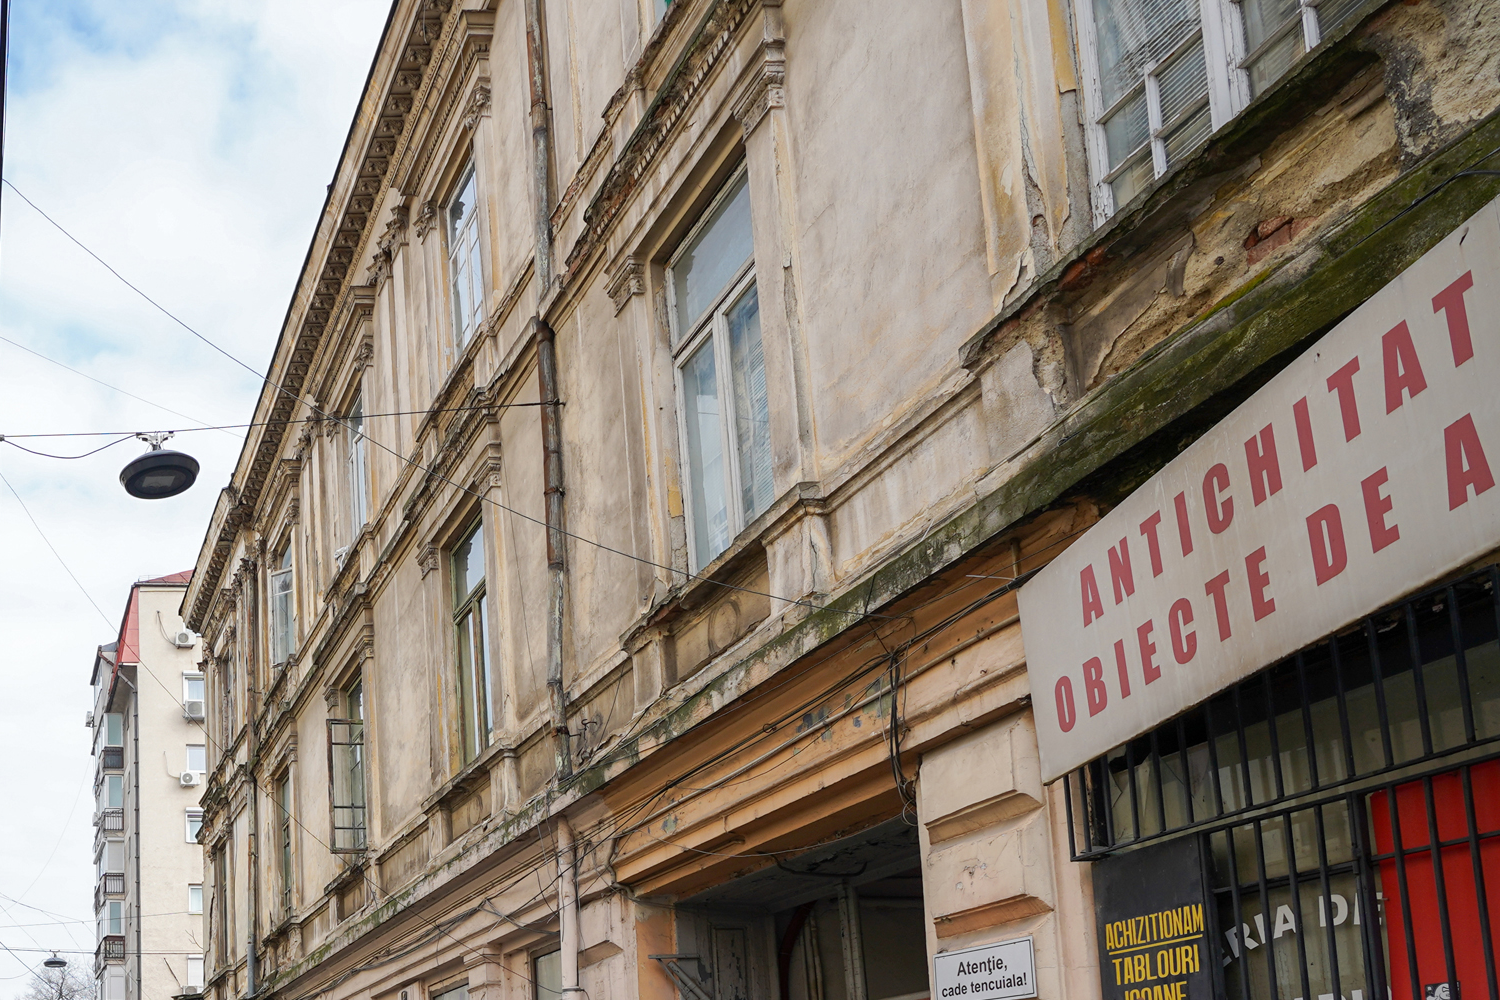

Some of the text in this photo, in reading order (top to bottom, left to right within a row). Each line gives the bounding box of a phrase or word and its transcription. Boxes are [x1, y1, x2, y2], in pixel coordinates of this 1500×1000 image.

[1053, 412, 1496, 734] OBIECTE DE A
[1105, 903, 1204, 950] ACHIZITIONAM
[942, 972, 1027, 998] cade tencuiala!
[1112, 944, 1200, 985] TABLOURI
